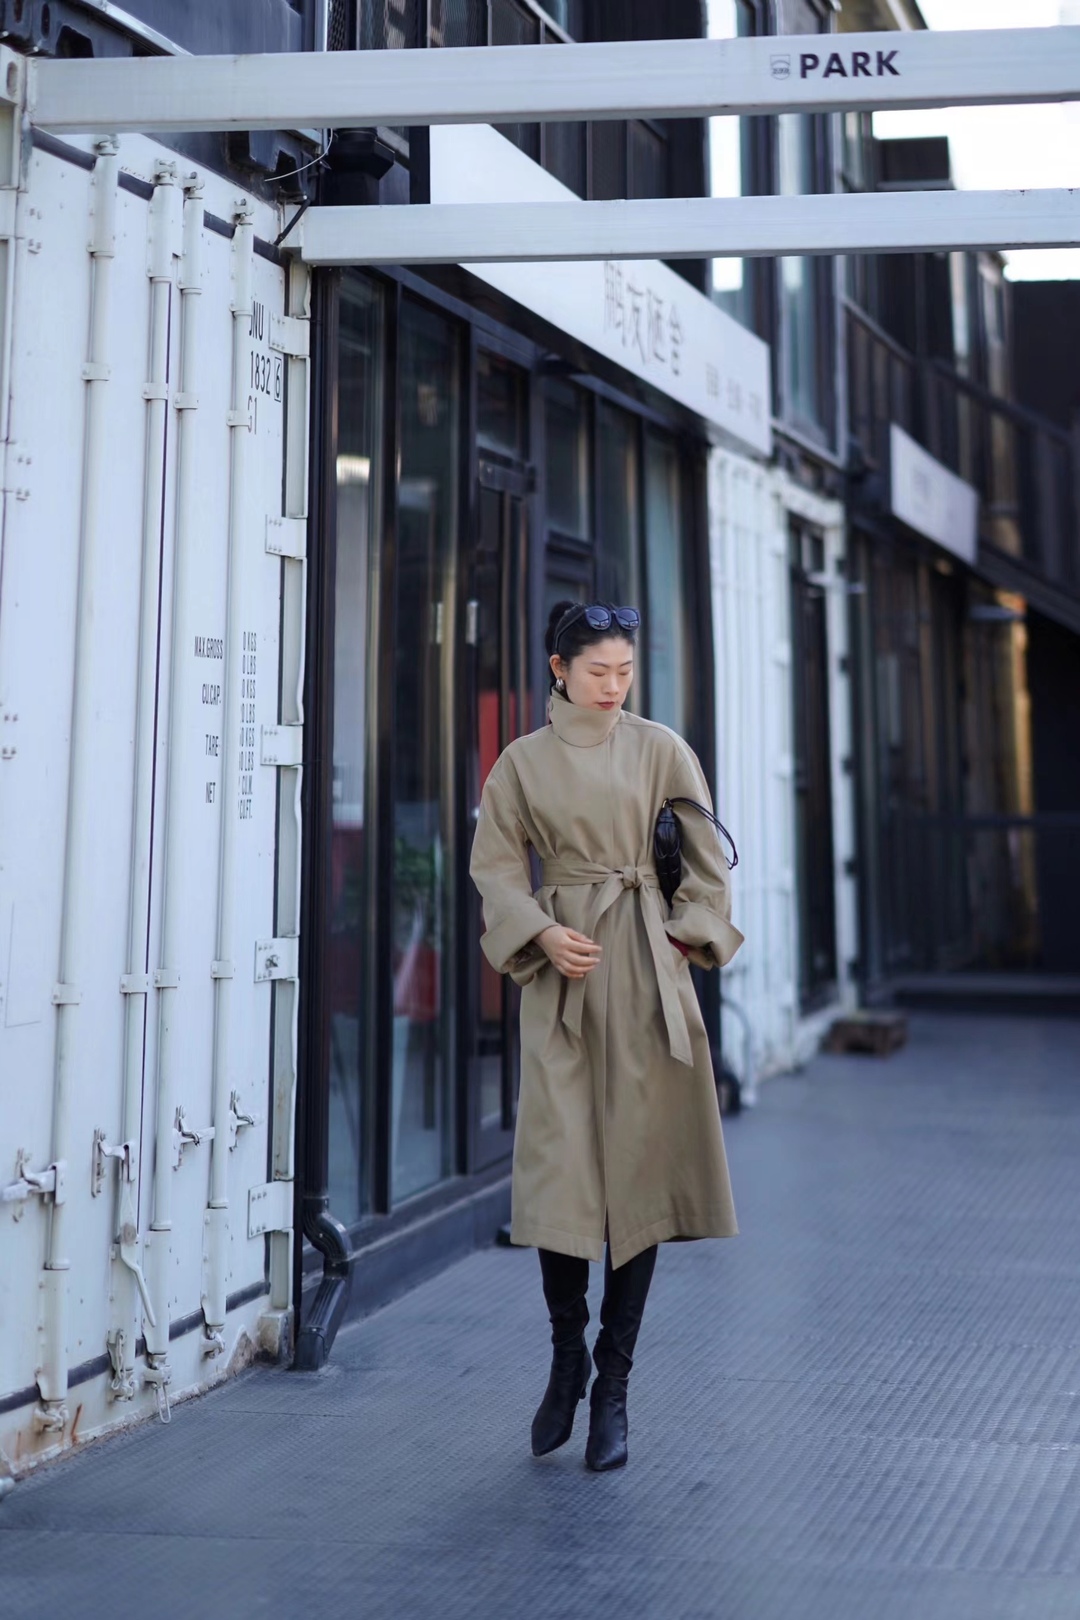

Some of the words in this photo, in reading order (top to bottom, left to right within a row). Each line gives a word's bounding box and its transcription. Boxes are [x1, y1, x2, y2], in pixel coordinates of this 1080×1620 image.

[800, 50, 901, 79] PARK
[250, 350, 271, 396] 1832
[247, 631, 257, 652] KGS
[246, 654, 256, 675] LBS
[246, 679, 256, 699] KGS
[246, 703, 255, 724] LBS
[205, 734, 219, 757] TARE
[245, 727, 255, 747] KGS
[245, 751, 254, 771] LBS
[205, 782, 216, 803] NET
